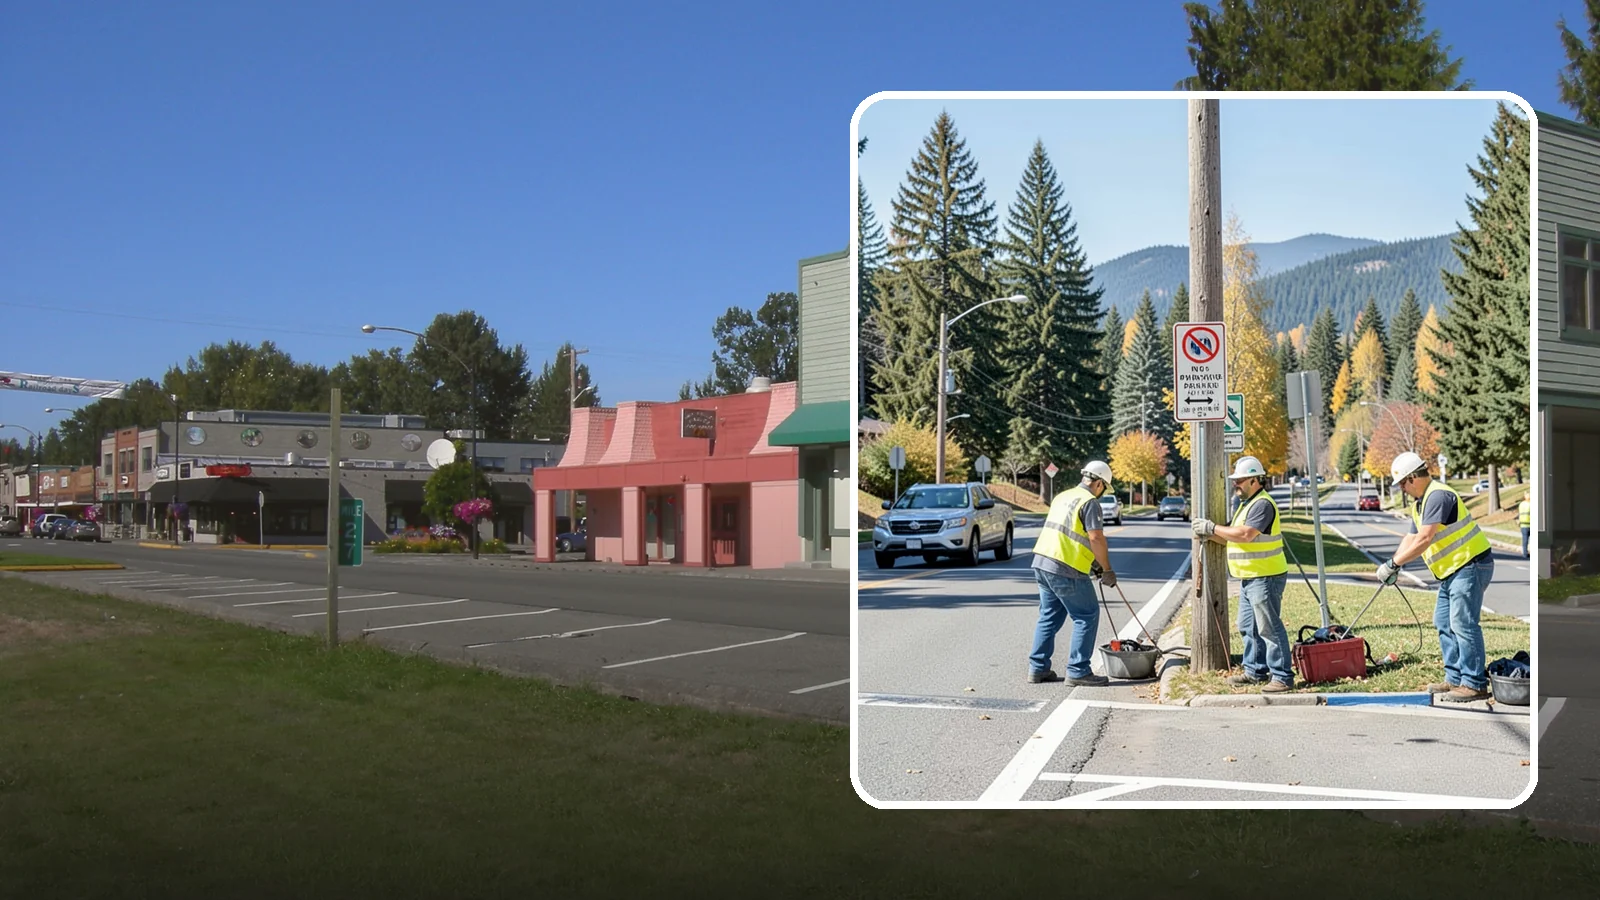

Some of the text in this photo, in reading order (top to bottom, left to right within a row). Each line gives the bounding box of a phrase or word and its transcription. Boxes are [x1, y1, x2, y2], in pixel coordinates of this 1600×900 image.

[20, 379, 57, 391] Railroad
[341, 505, 362, 517] MILE
[344, 522, 357, 539] 2
[344, 542, 356, 559] 7
